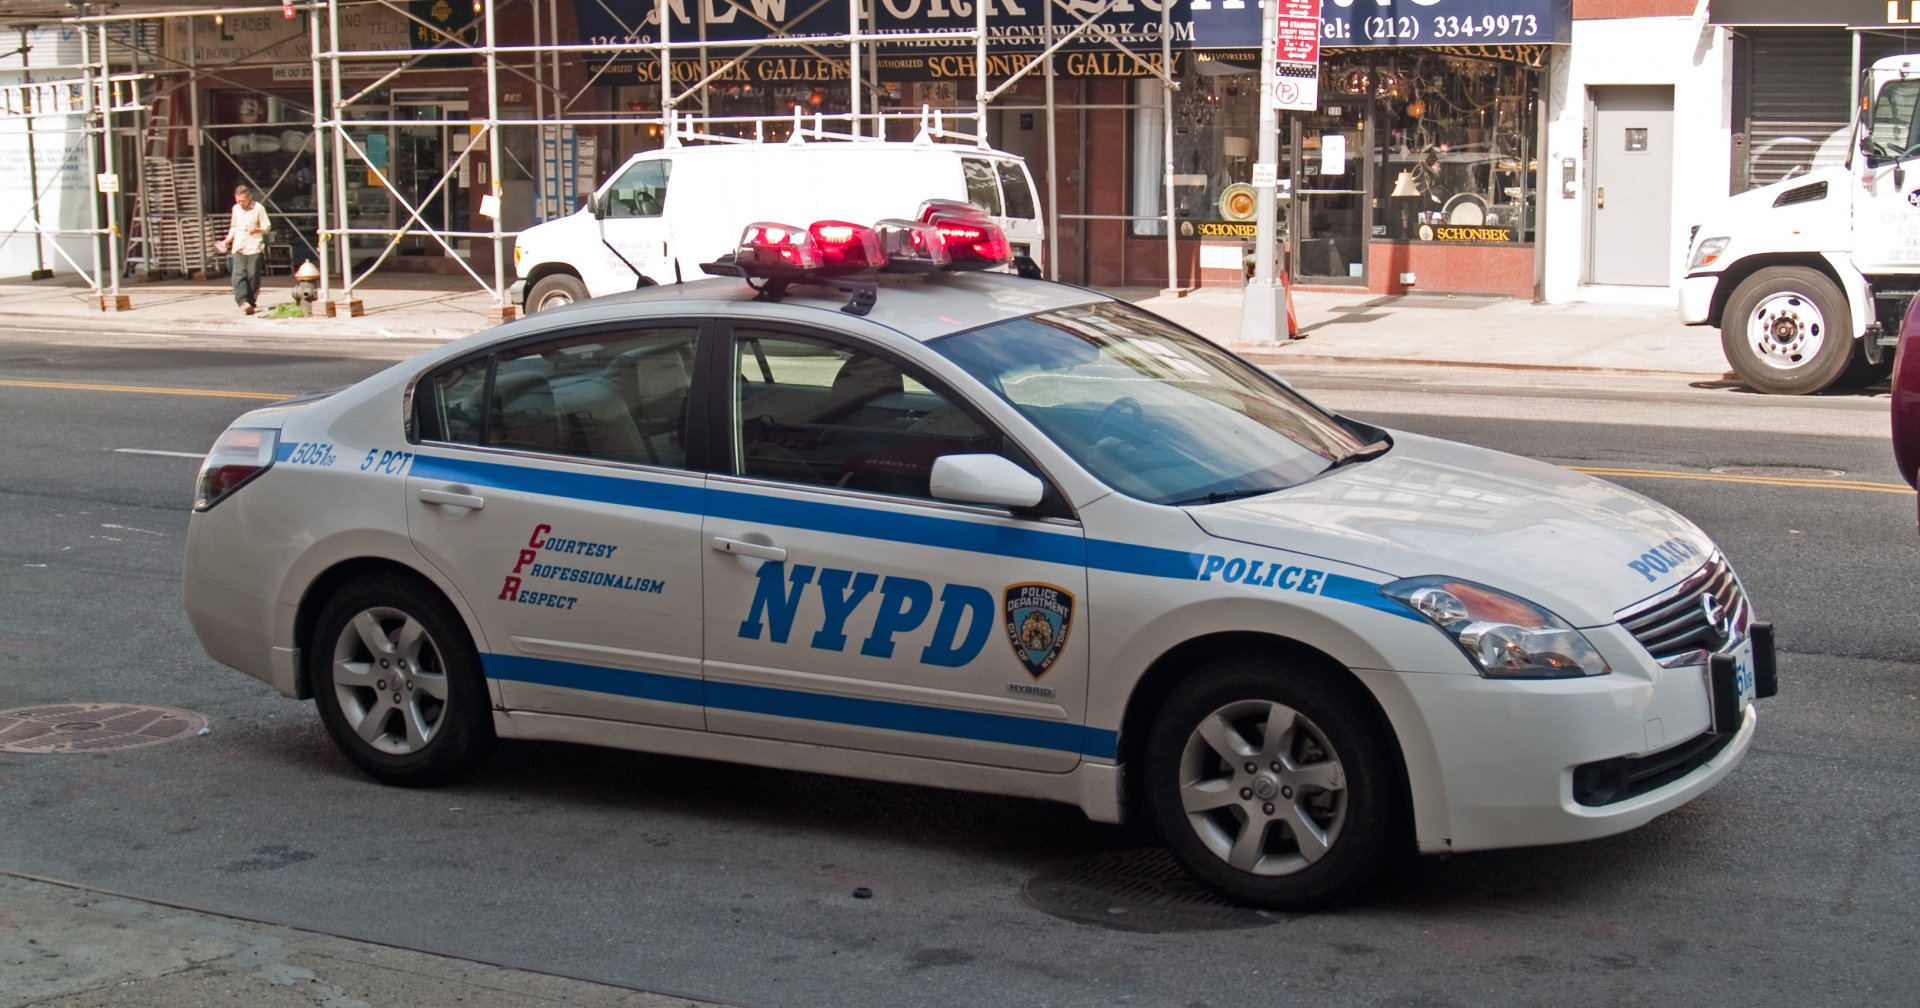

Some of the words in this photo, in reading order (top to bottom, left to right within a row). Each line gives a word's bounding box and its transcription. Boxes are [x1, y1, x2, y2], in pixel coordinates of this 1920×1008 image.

[221, 13, 271, 41] LEADER
[1364, 15, 1420, 41] (212)
[1433, 14, 1539, 38] 334-9973
[877, 60, 924, 69] UTHORIZED
[1067, 52, 1182, 76] GALLERY
[1198, 52, 1256, 62] AUTHORIZED
[1197, 223, 1257, 237] SCHONBE
[1437, 228, 1510, 241] SCHONBEK
[360, 448, 378, 471] 5
[375, 450, 414, 475] PCT
[528, 523, 617, 559] COURTESY
[512, 548, 666, 595] PROFESSIONALISM
[1626, 536, 1701, 583] POLICE
[1199, 554, 1325, 595] POLICE
[498, 575, 578, 611] RESPECT
[1021, 587, 1059, 601] POLICE
[737, 560, 996, 669] NYPD
[1007, 597, 1070, 618] DEPARTMENT
[1008, 623, 1021, 646] CITY
[1017, 649, 1029, 661] OF
[1041, 651, 1057, 669] NEW
[1055, 624, 1069, 648] YORK
[1009, 684, 1053, 696] HYBRID
